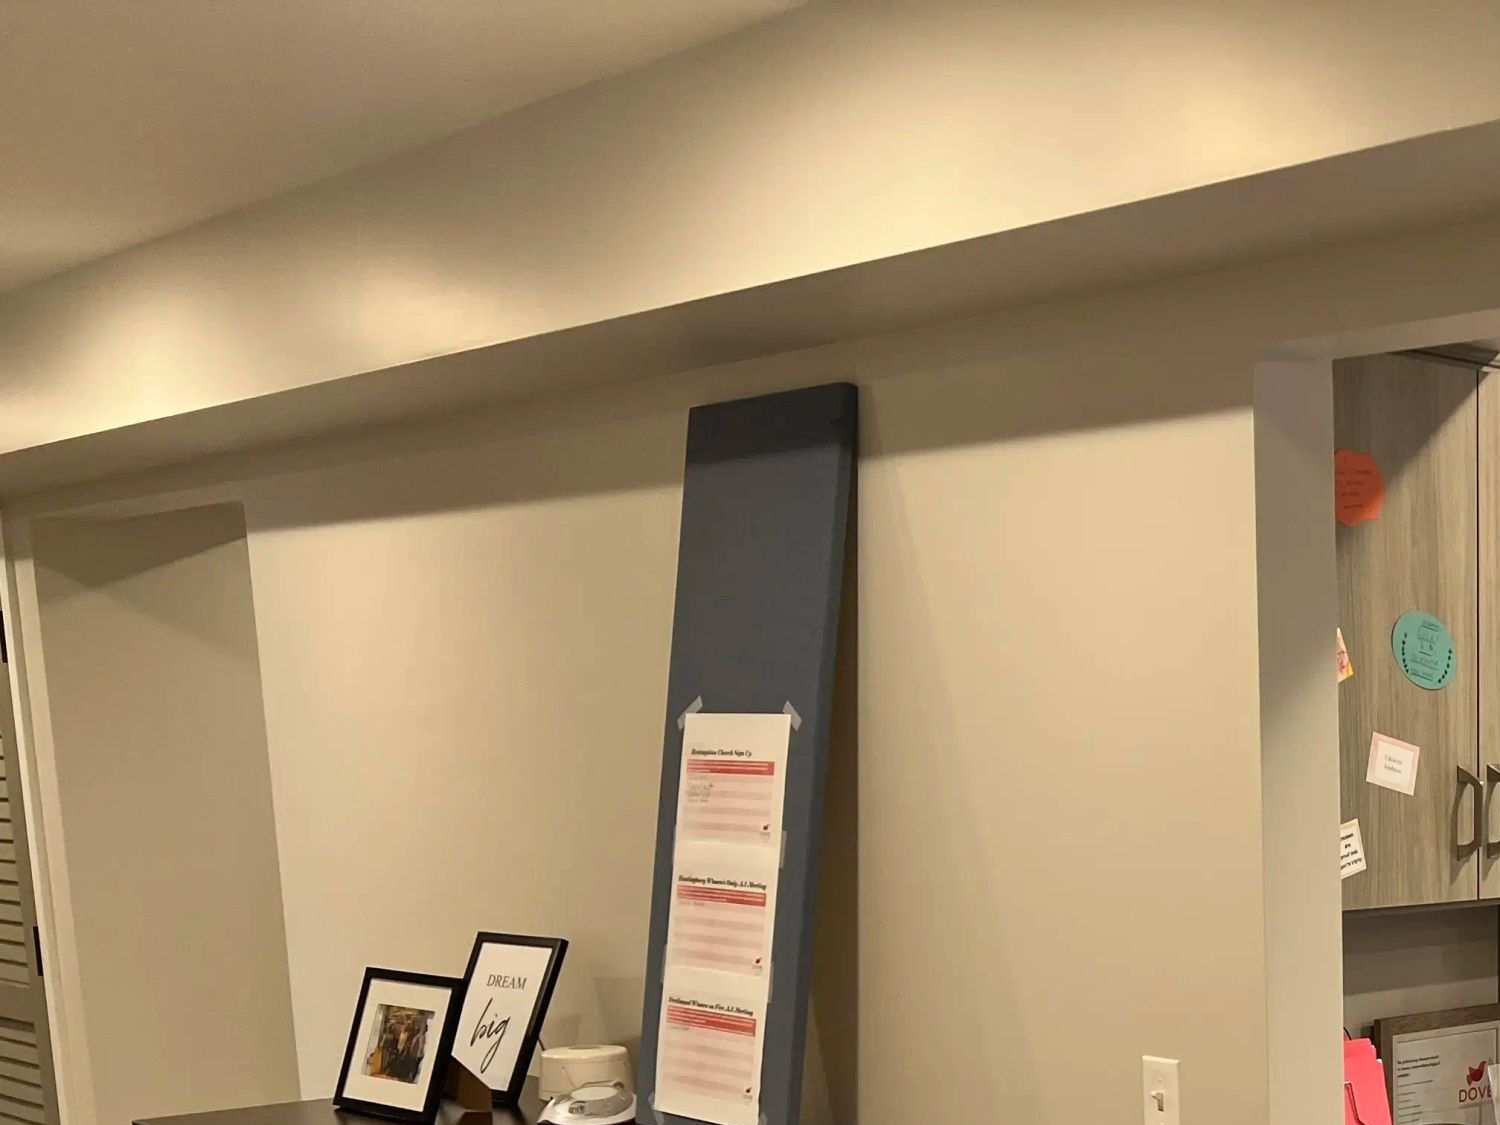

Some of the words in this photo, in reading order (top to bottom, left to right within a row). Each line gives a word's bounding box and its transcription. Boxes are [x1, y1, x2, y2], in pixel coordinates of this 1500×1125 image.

[486, 974, 527, 990] DREAM
[470, 997, 511, 1074] big
[1458, 1085, 1492, 1103] DOVE
